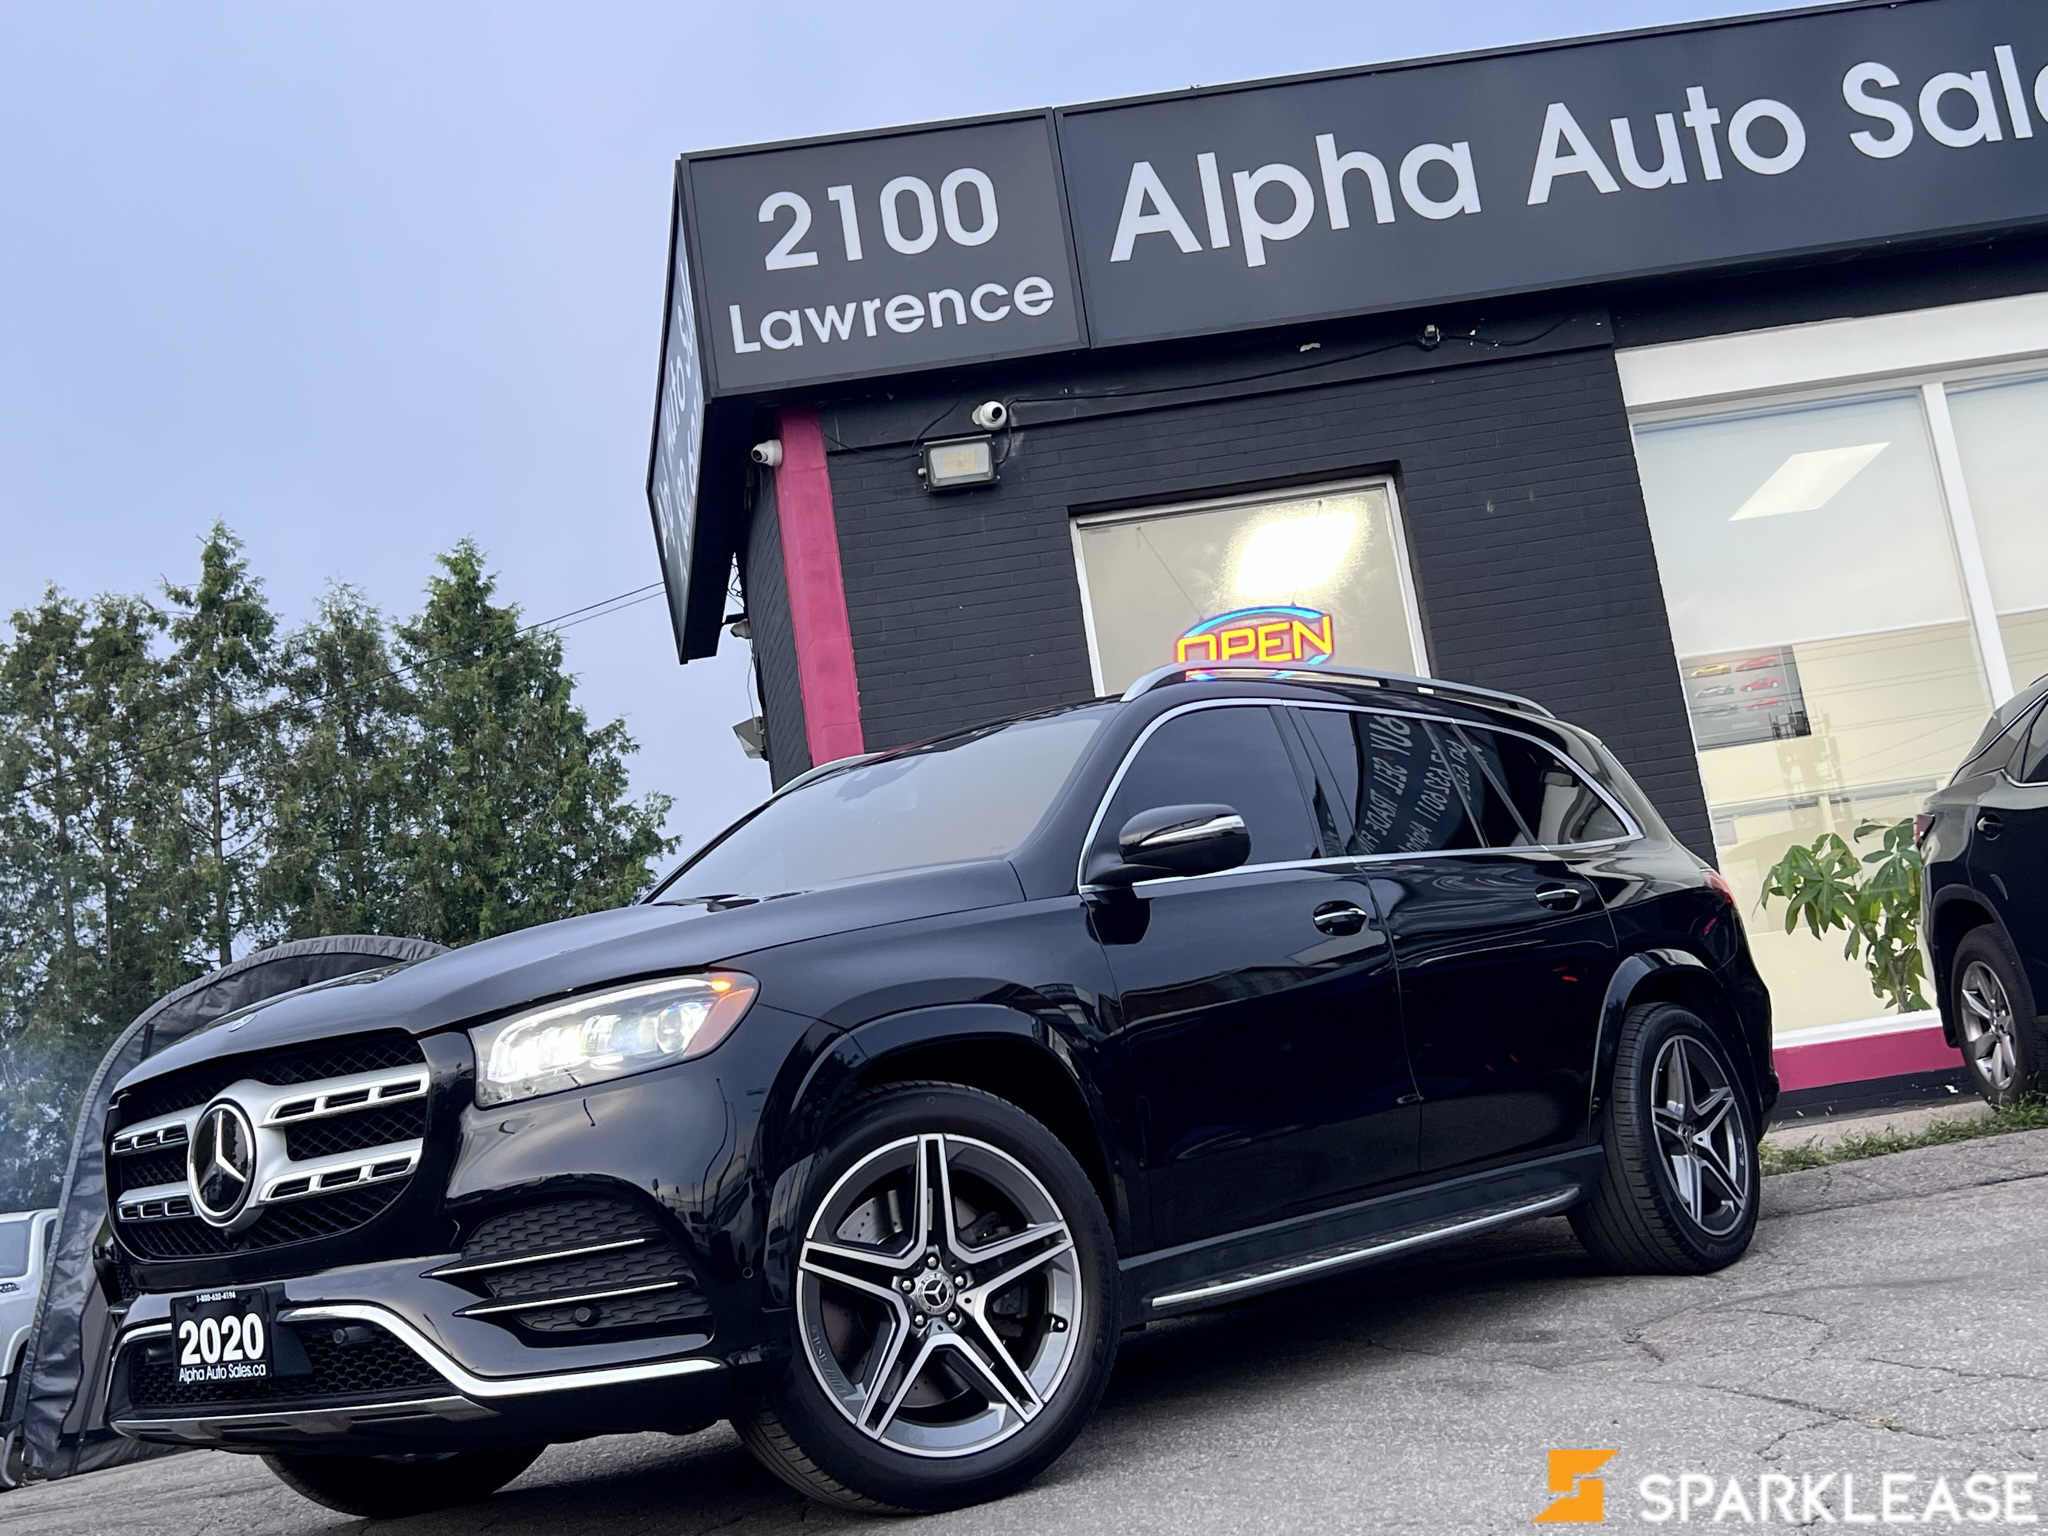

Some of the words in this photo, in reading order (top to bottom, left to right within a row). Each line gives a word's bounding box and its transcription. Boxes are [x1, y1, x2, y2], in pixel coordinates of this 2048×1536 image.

[1109, 132, 1483, 268] Alpha
[1526, 85, 1807, 206] Auto
[757, 167, 999, 271] 2100
[728, 275, 1055, 354] Lawrence
[1176, 614, 1333, 664] OPEN
[178, 1312, 265, 1366] 2020
[179, 1368, 205, 1384] Alpha
[207, 1366, 227, 1380] Auto
[229, 1364, 266, 1378] Sales.ca
